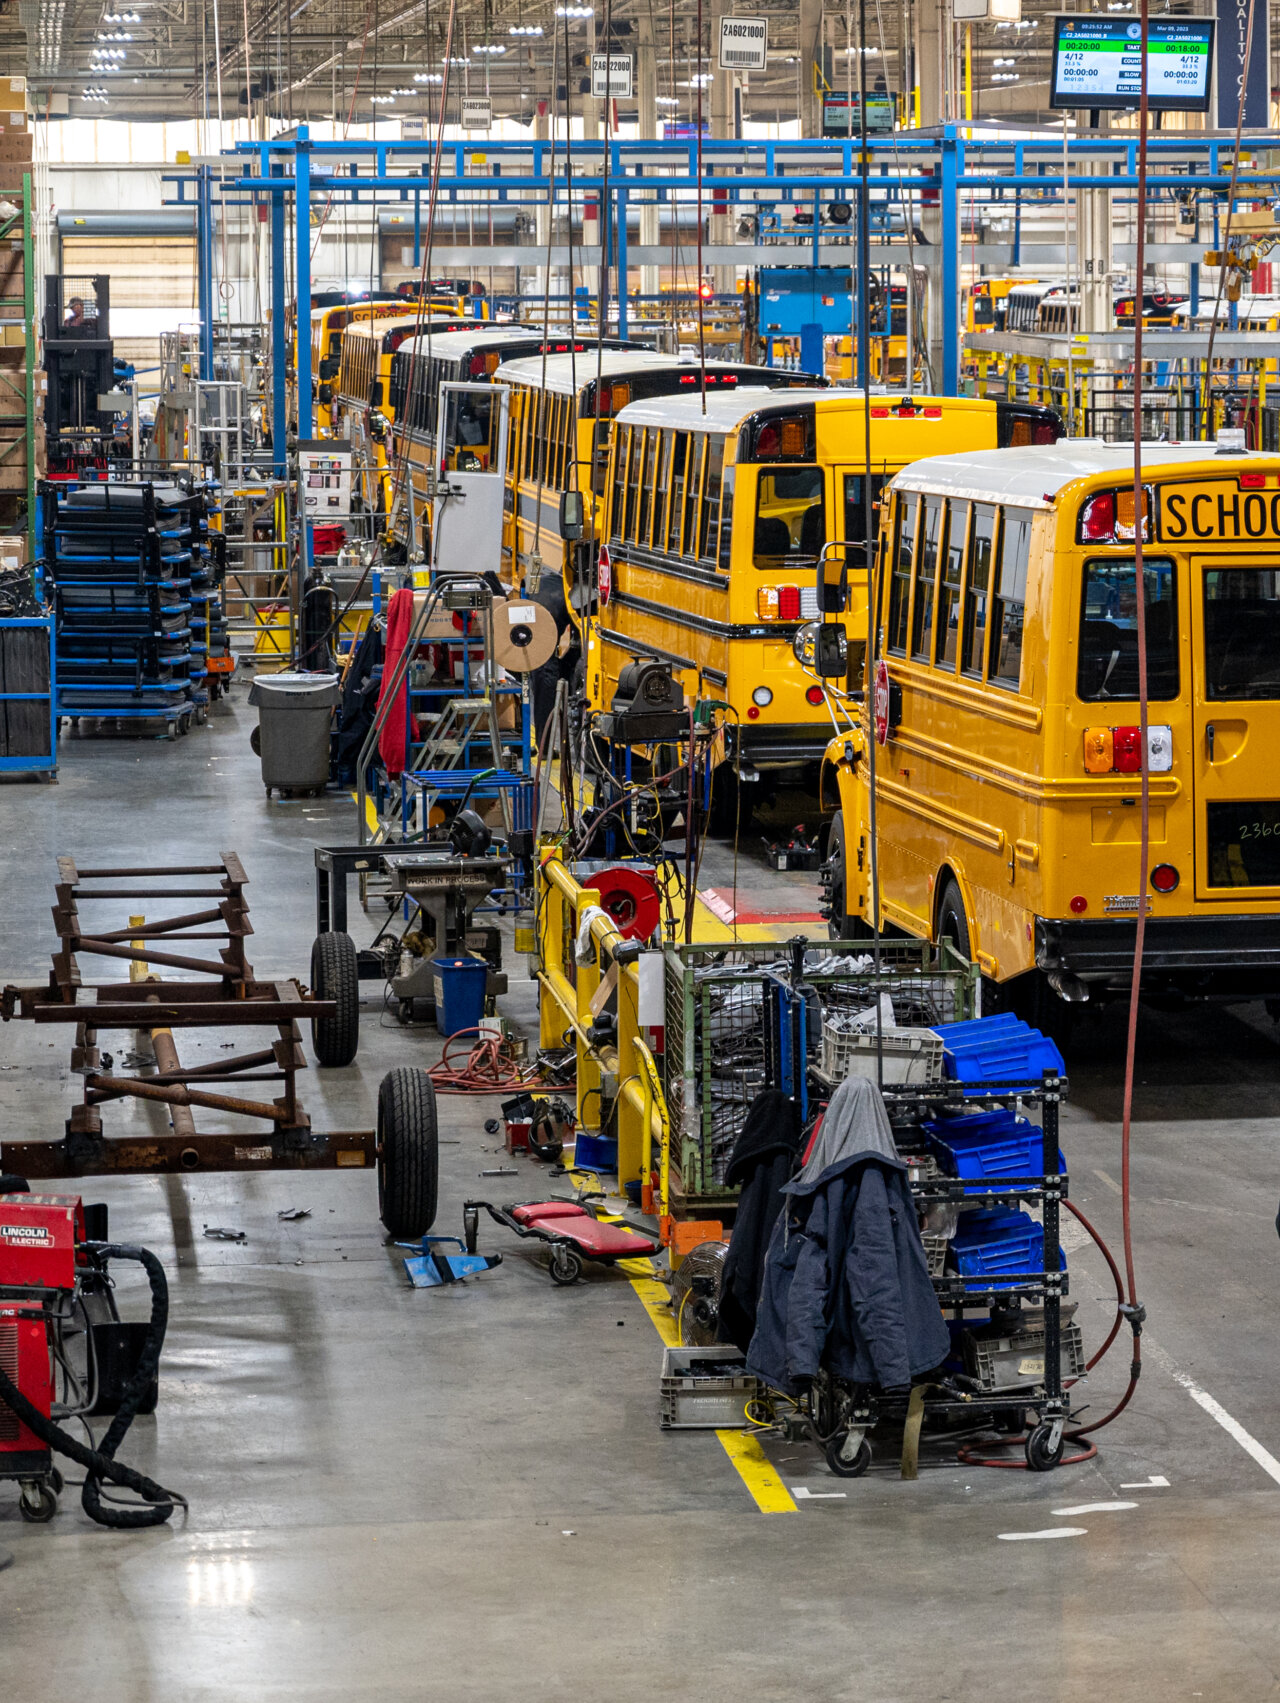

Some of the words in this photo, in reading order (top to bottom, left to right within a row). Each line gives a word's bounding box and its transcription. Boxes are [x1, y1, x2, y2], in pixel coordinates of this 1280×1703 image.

[723, 24, 764, 38] 2A6021000
[1236, 0, 1246, 64] UALITY
[594, 61, 630, 71] 2A622000
[446, 876, 485, 884] PROCESS
[2, 1228, 45, 1237] LINCOLN
[12, 1238, 49, 1246] ELECTRIC
